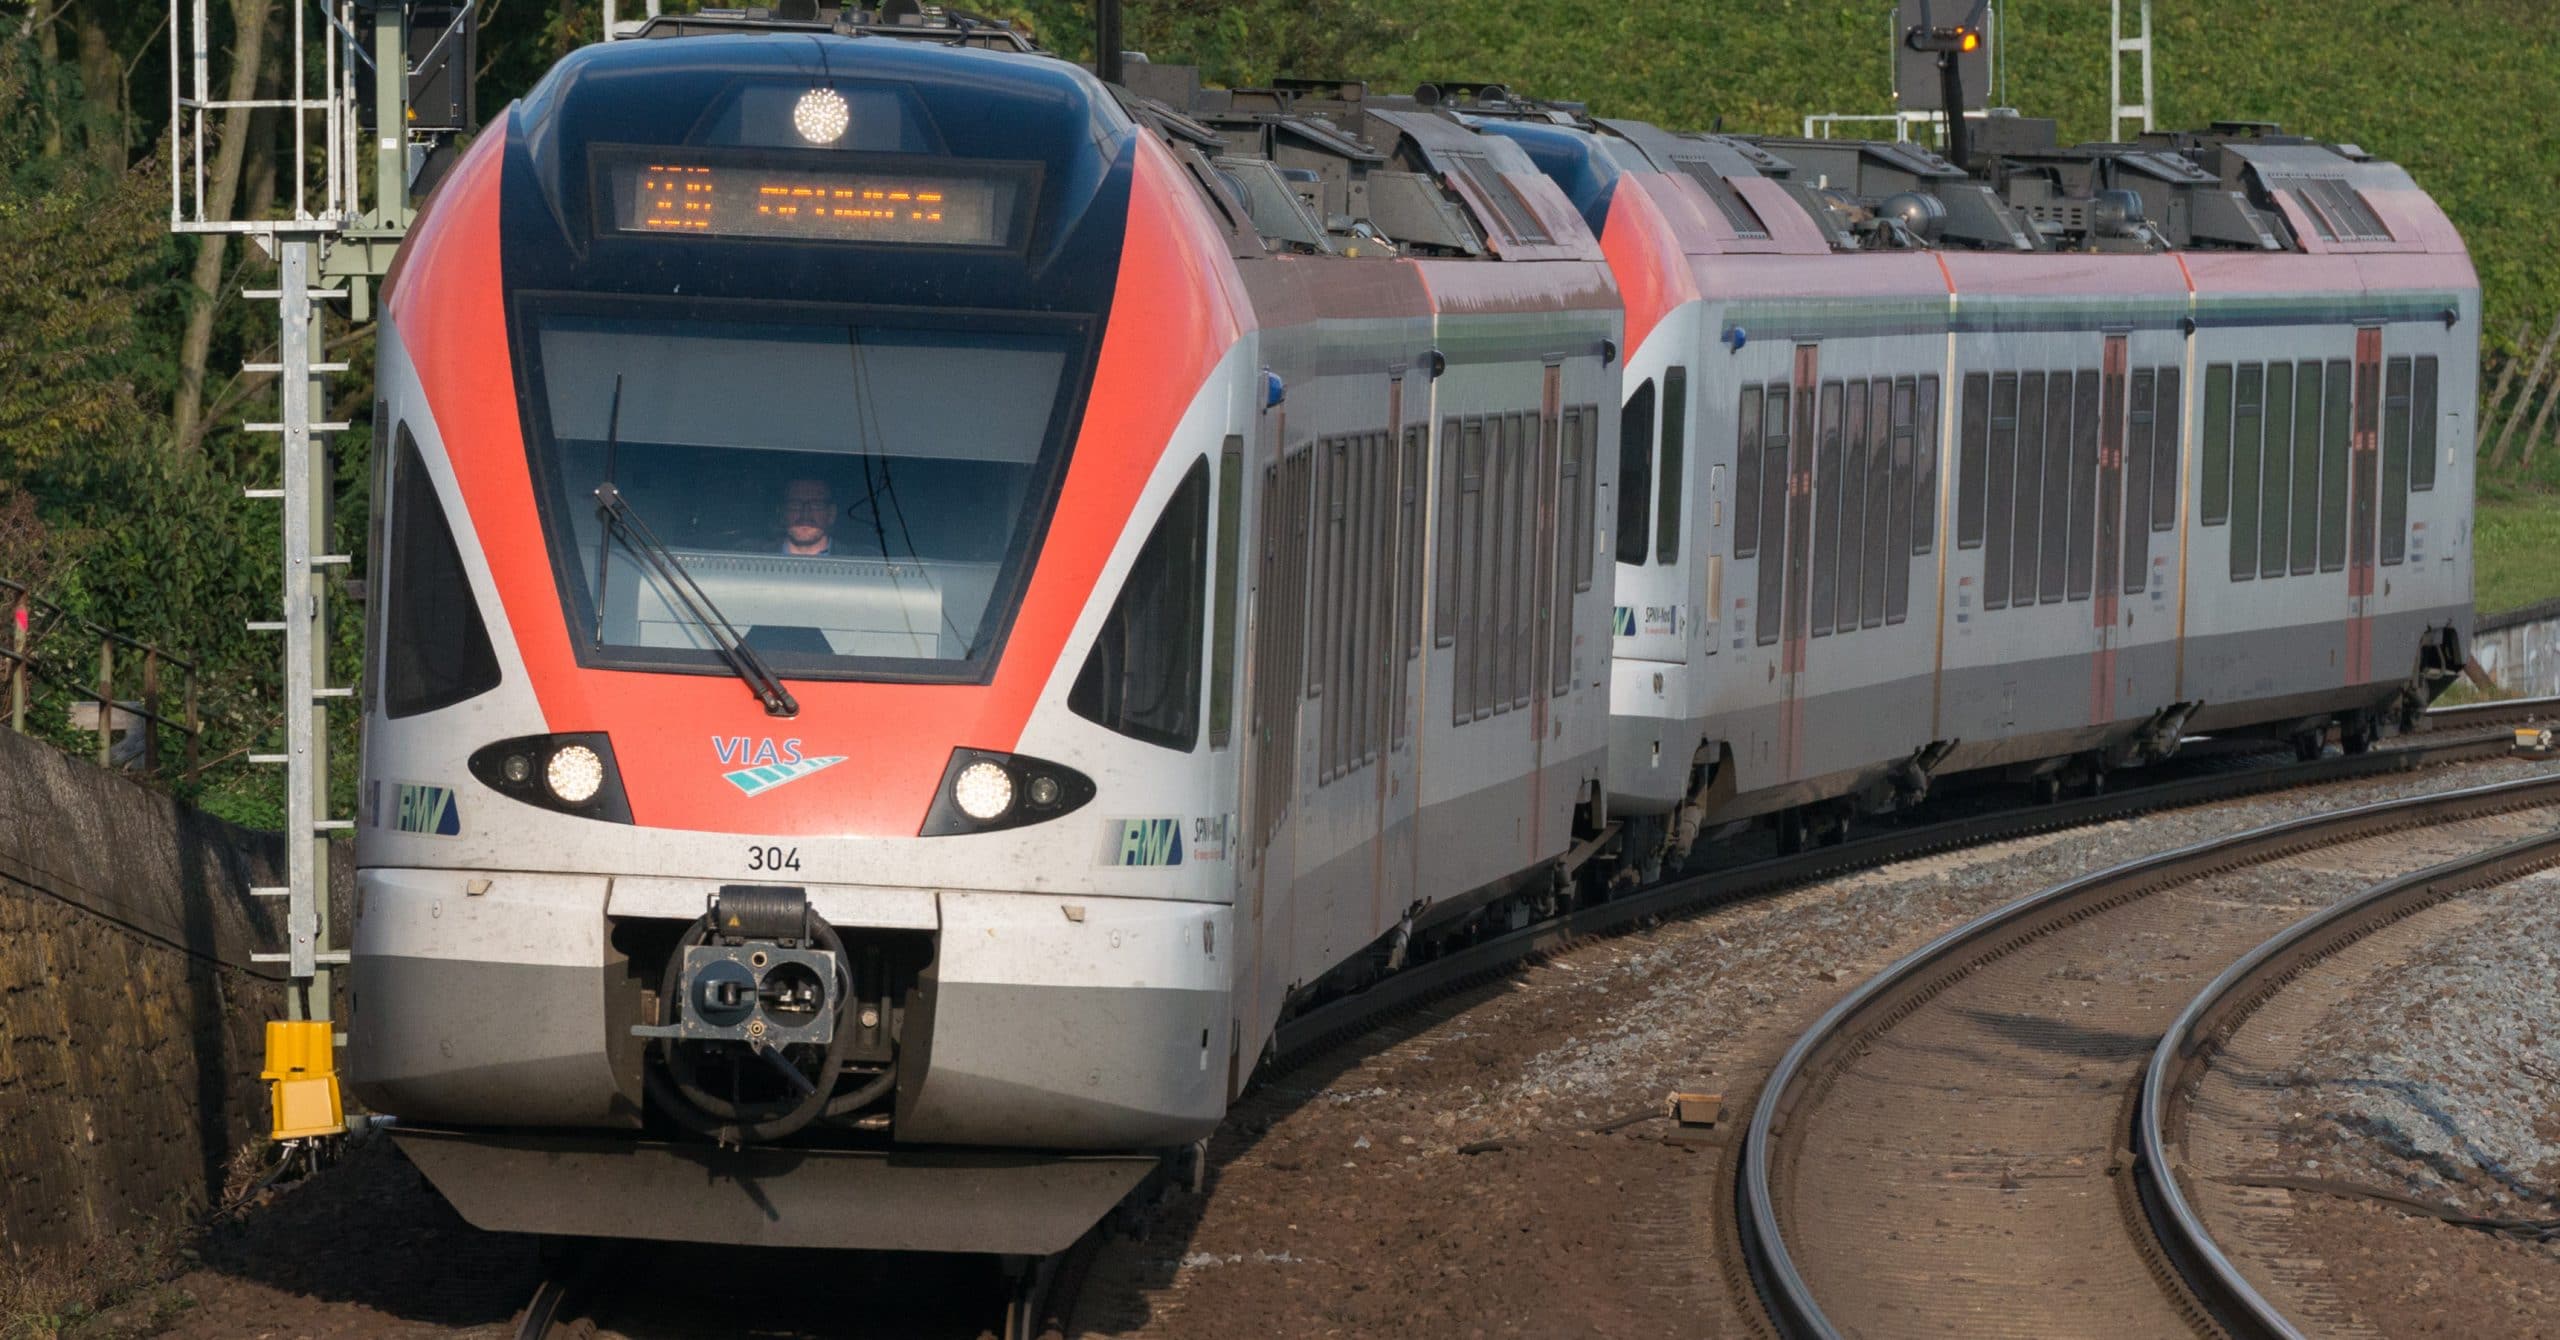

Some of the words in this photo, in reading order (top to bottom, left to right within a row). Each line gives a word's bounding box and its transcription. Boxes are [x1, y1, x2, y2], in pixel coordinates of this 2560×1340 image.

[711, 736, 804, 766] VIAS
[397, 782, 452, 833] RMV
[748, 846, 801, 871] 304
[1119, 818, 1180, 866] RMV
